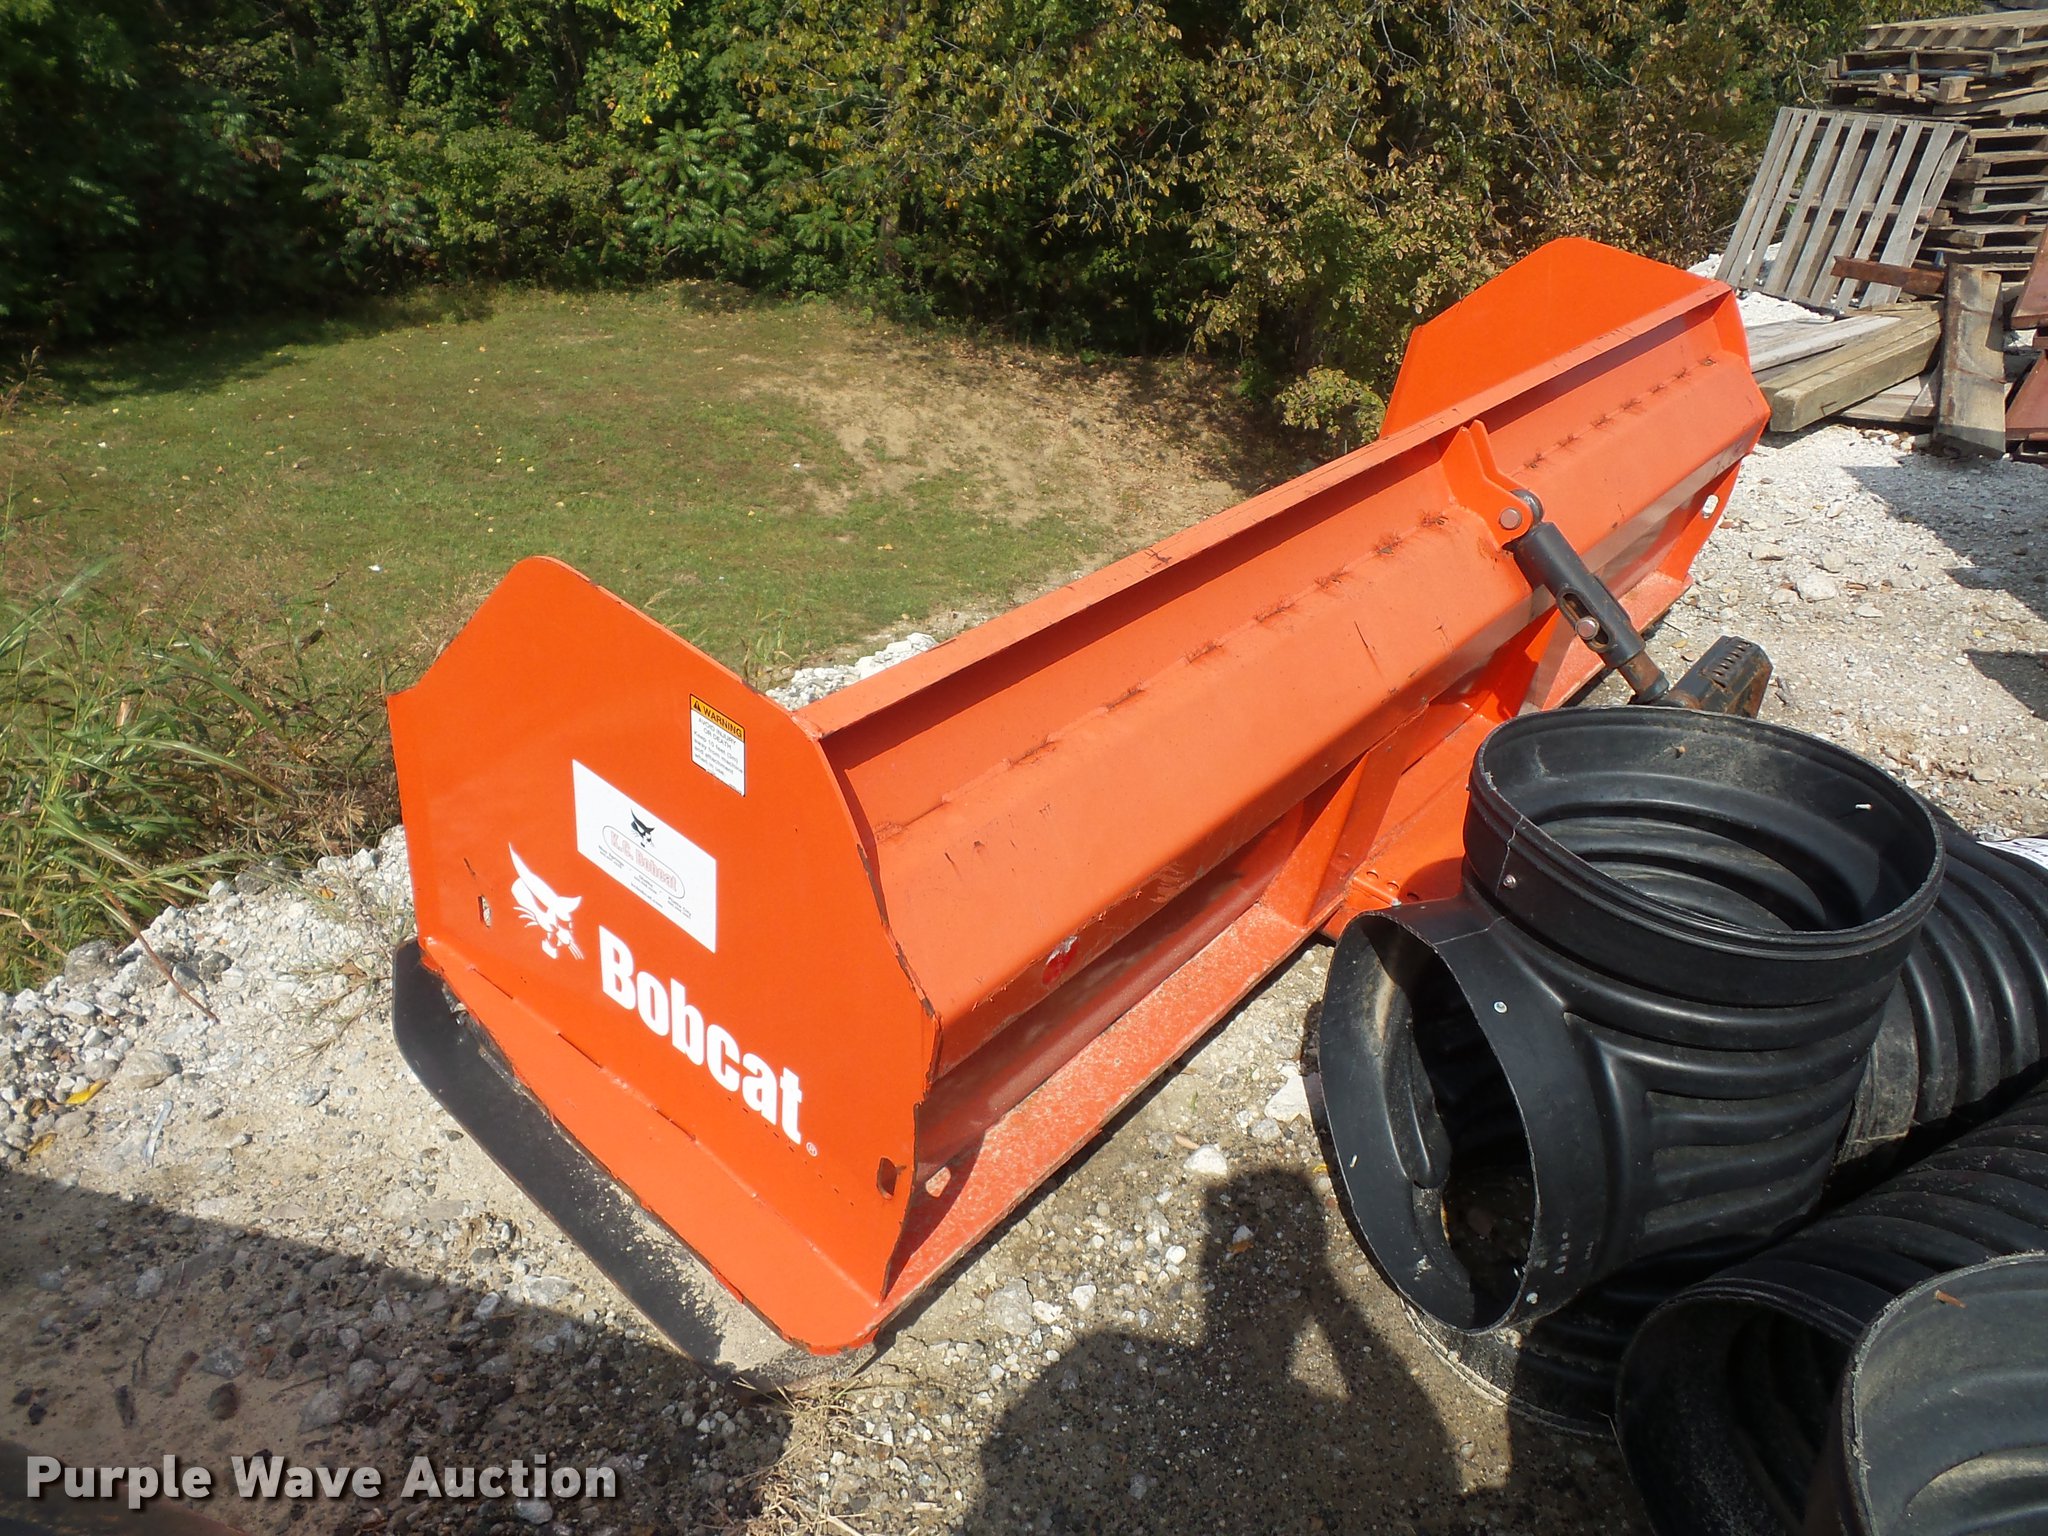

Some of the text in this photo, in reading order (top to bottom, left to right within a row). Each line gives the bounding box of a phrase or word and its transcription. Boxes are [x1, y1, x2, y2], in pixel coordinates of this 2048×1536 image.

[698, 718, 737, 745] AVOID INJURY
[703, 707, 742, 738] WARNING
[703, 728, 732, 750] OR DEATH
[598, 924, 803, 1146] Bobcat
